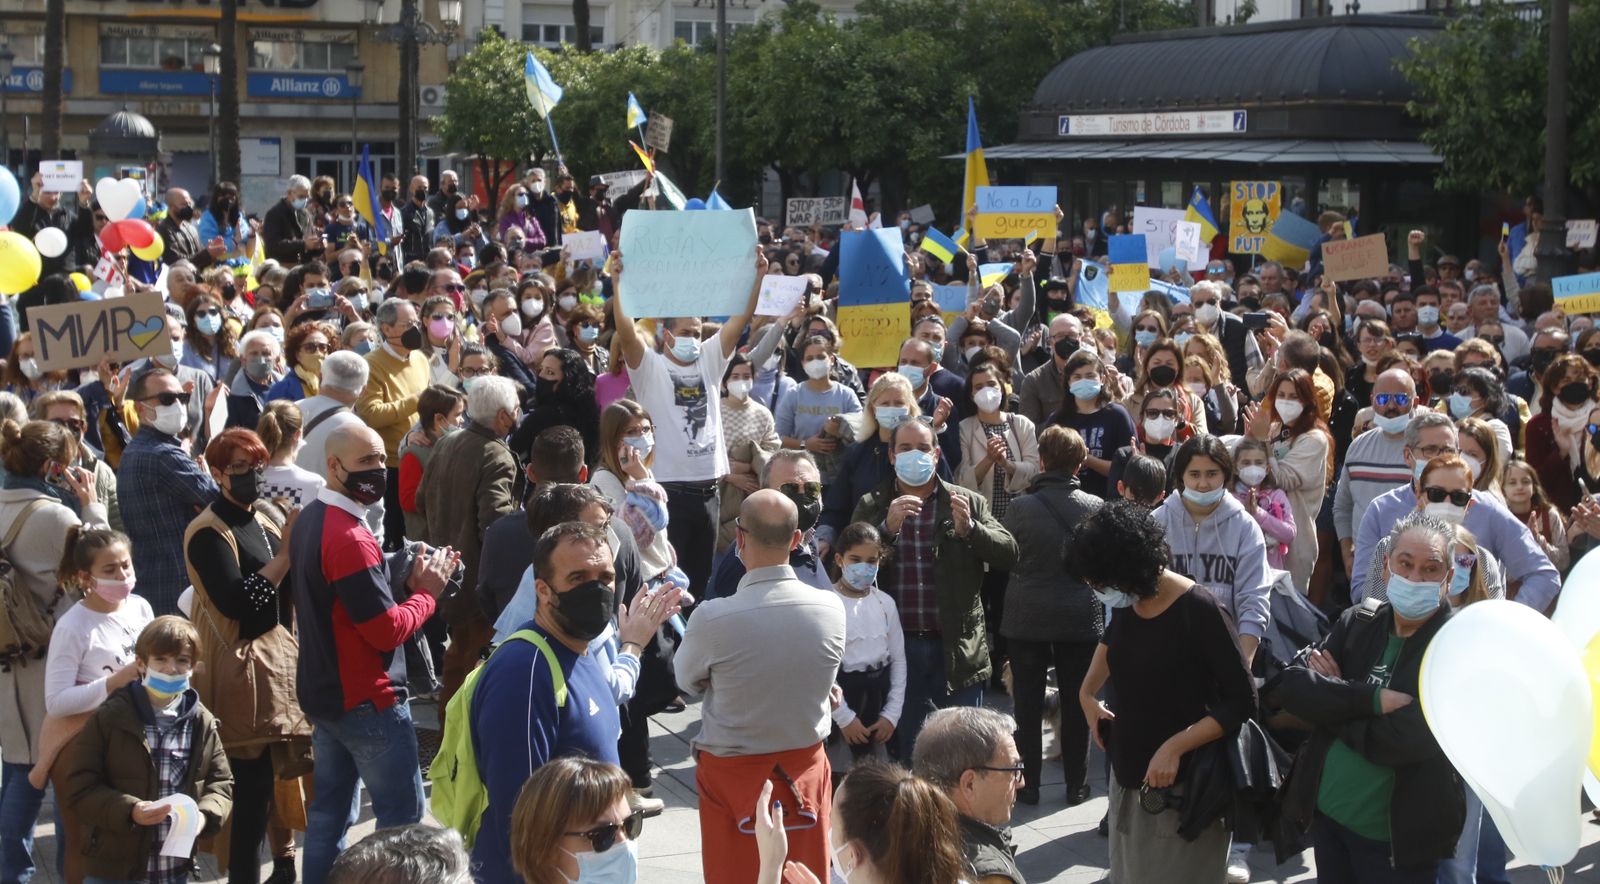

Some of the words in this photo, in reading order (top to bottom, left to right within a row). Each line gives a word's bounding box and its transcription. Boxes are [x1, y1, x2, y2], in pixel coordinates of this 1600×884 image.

[271, 77, 319, 93] Allianz
[1108, 116, 1139, 133] Turismo
[1141, 115, 1152, 132] de
[1154, 114, 1190, 132] Córdoba
[986, 189, 1004, 209] No
[1009, 198, 1019, 209] a
[1235, 182, 1277, 201] STOP
[789, 199, 815, 213] STOP
[823, 197, 842, 209] STOP
[789, 213, 812, 224] WAR
[631, 225, 694, 255] RUSIA
[36, 306, 136, 361] МИР
